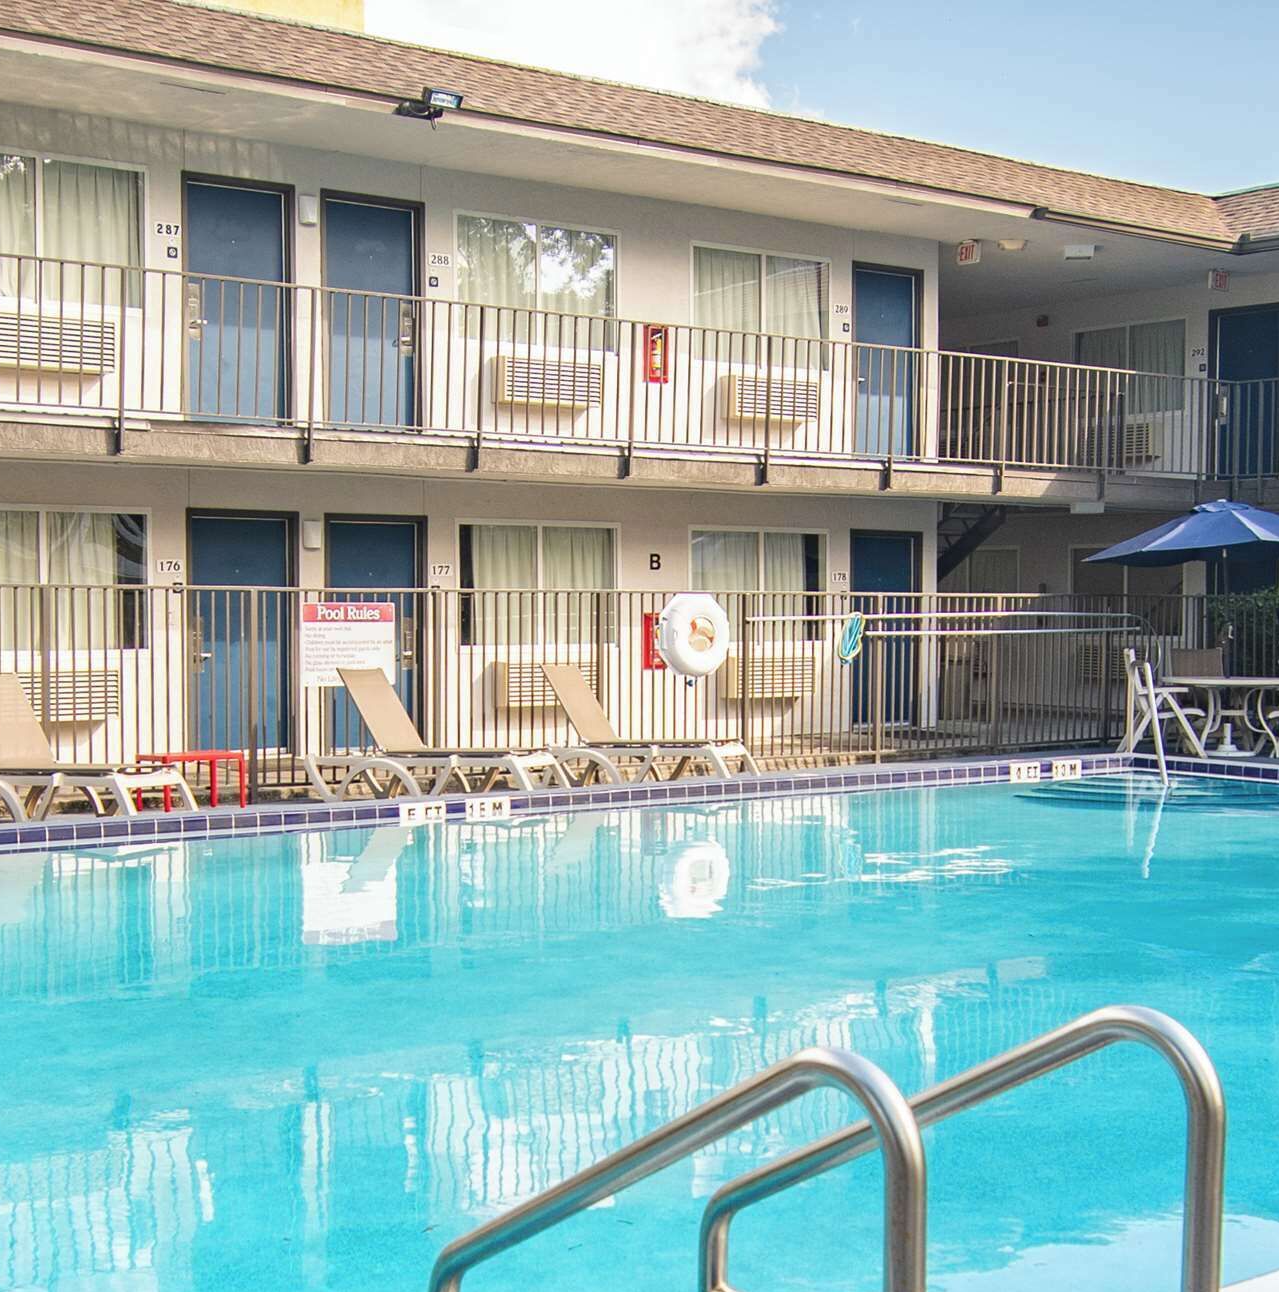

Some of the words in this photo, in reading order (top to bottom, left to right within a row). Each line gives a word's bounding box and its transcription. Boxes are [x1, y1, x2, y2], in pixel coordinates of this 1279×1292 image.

[156, 223, 180, 236] 287
[959, 244, 975, 261] EXIT
[431, 254, 450, 265] 288
[159, 560, 181, 571] 176
[649, 553, 661, 570] B
[432, 565, 450, 575] 177
[833, 572, 847, 581] 178
[316, 605, 345, 620] Pool
[346, 605, 380, 620] Rules
